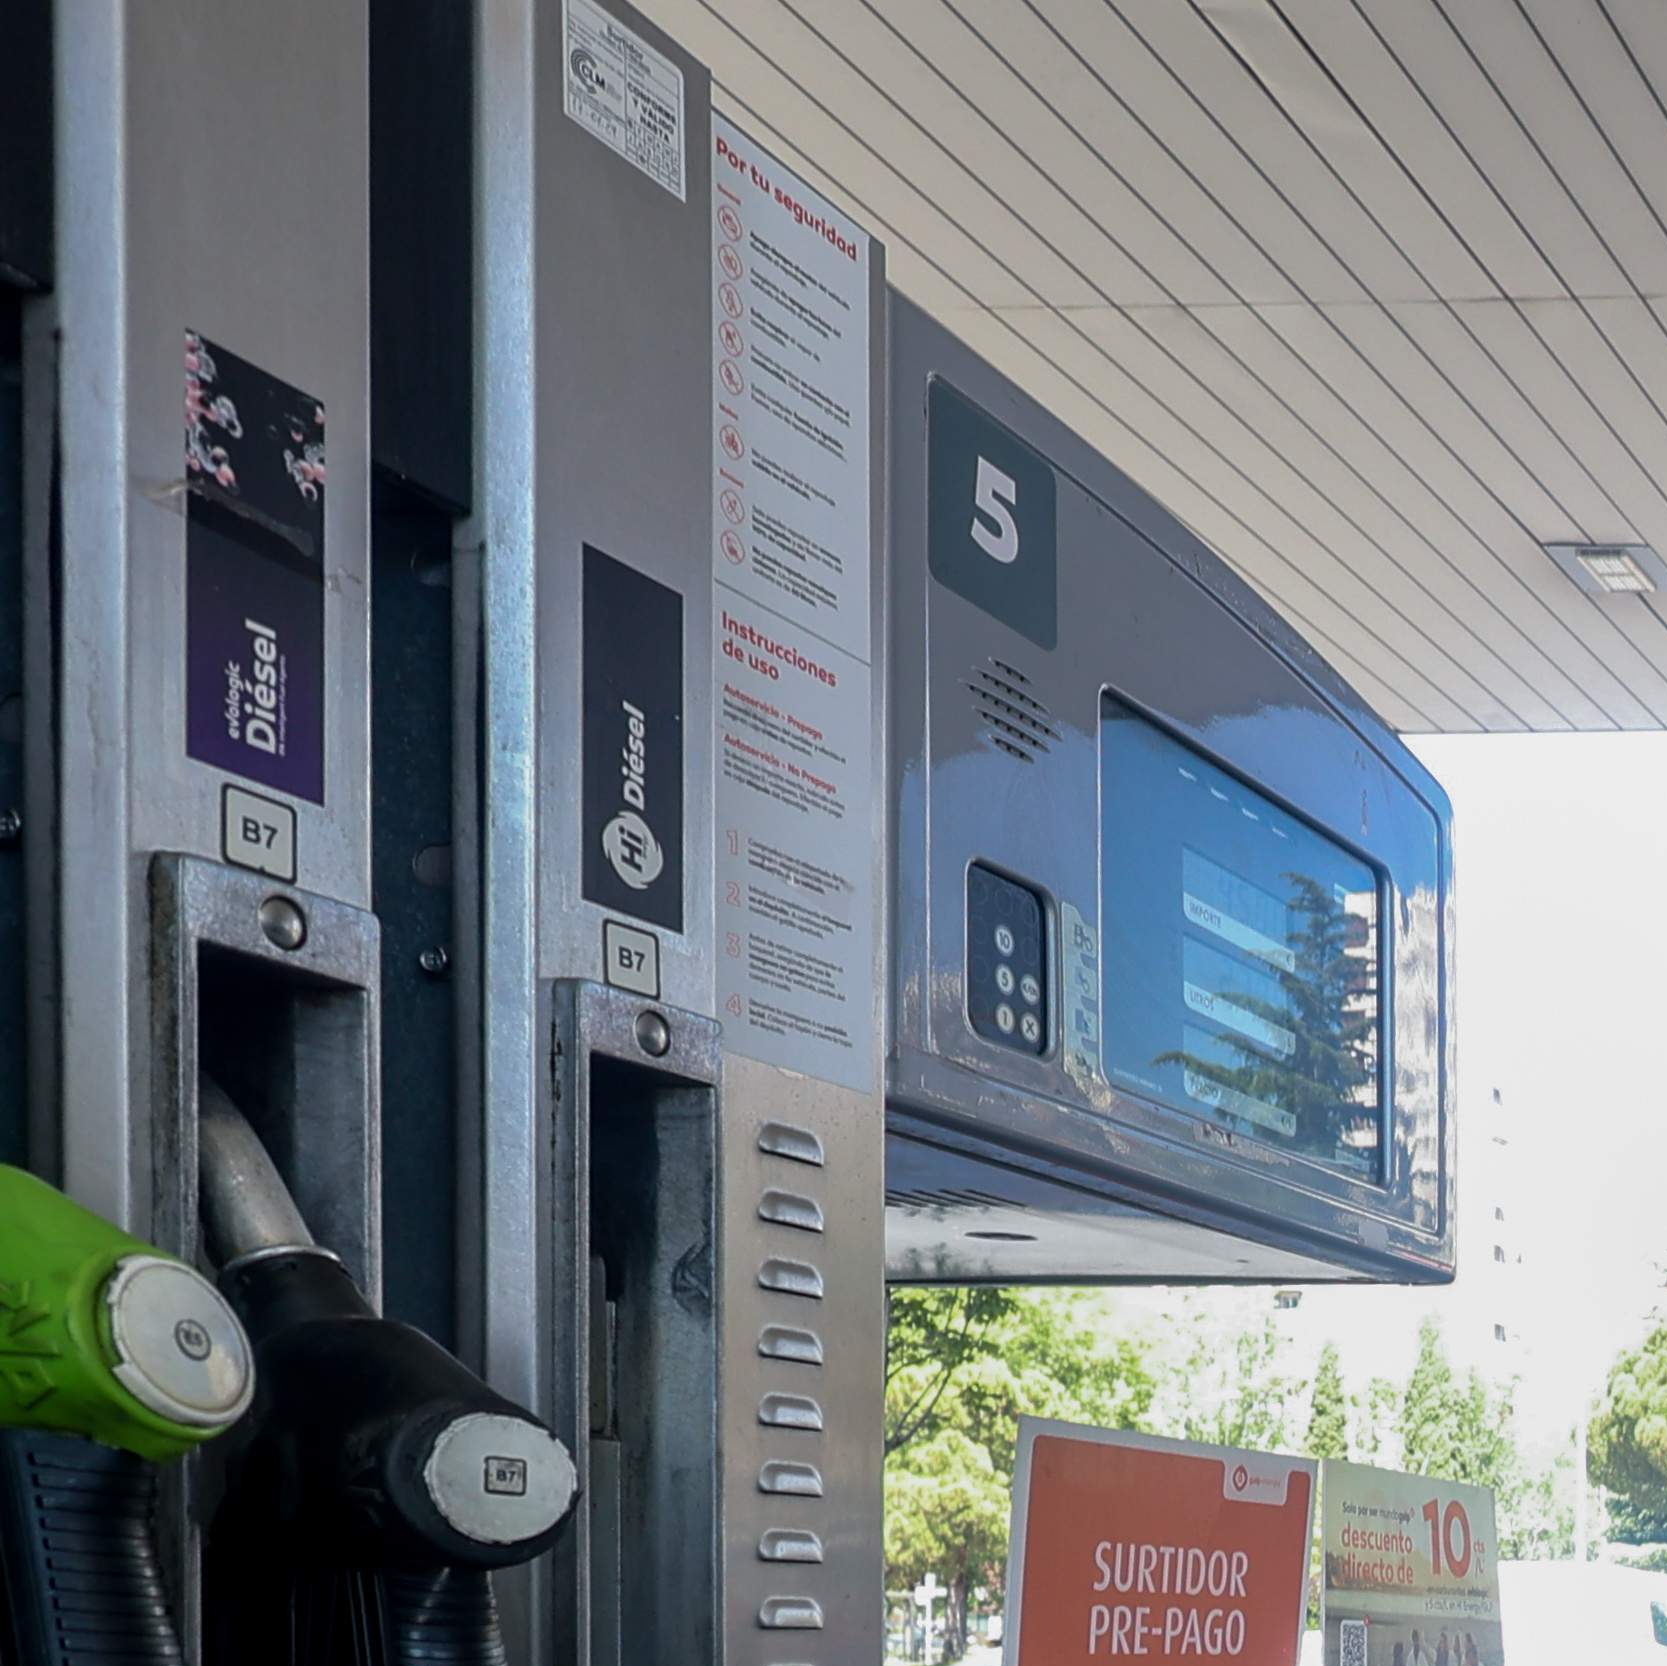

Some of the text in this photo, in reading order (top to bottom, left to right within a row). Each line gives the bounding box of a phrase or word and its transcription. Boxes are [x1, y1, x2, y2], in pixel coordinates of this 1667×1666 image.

[716, 136, 747, 173] Por
[750, 166, 770, 194] tu
[773, 186, 857, 262] seguridad
[968, 456, 1019, 565] 5
[722, 610, 837, 688] Instrucciones
[722, 638, 779, 681] de uso
[225, 660, 245, 741] evologic
[245, 617, 277, 755] Diésel
[723, 683, 780, 721] Autoservicio
[622, 700, 645, 812] Diésel
[241, 816, 278, 849] B7
[620, 824, 643, 873] Hi
[618, 945, 646, 972] B7
[496, 1469, 516, 1482] B7
[1342, 1501, 1357, 1515] Solo
[1358, 1505, 1369, 1516] por
[1341, 1521, 1413, 1554] descuento
[1422, 1498, 1472, 1579] 10
[1473, 1538, 1485, 1554] cts
[1093, 1541, 1249, 1598] SURTIDOR
[1342, 1552, 1414, 1585] directo de
[1089, 1604, 1246, 1656] PRE-PAGO
